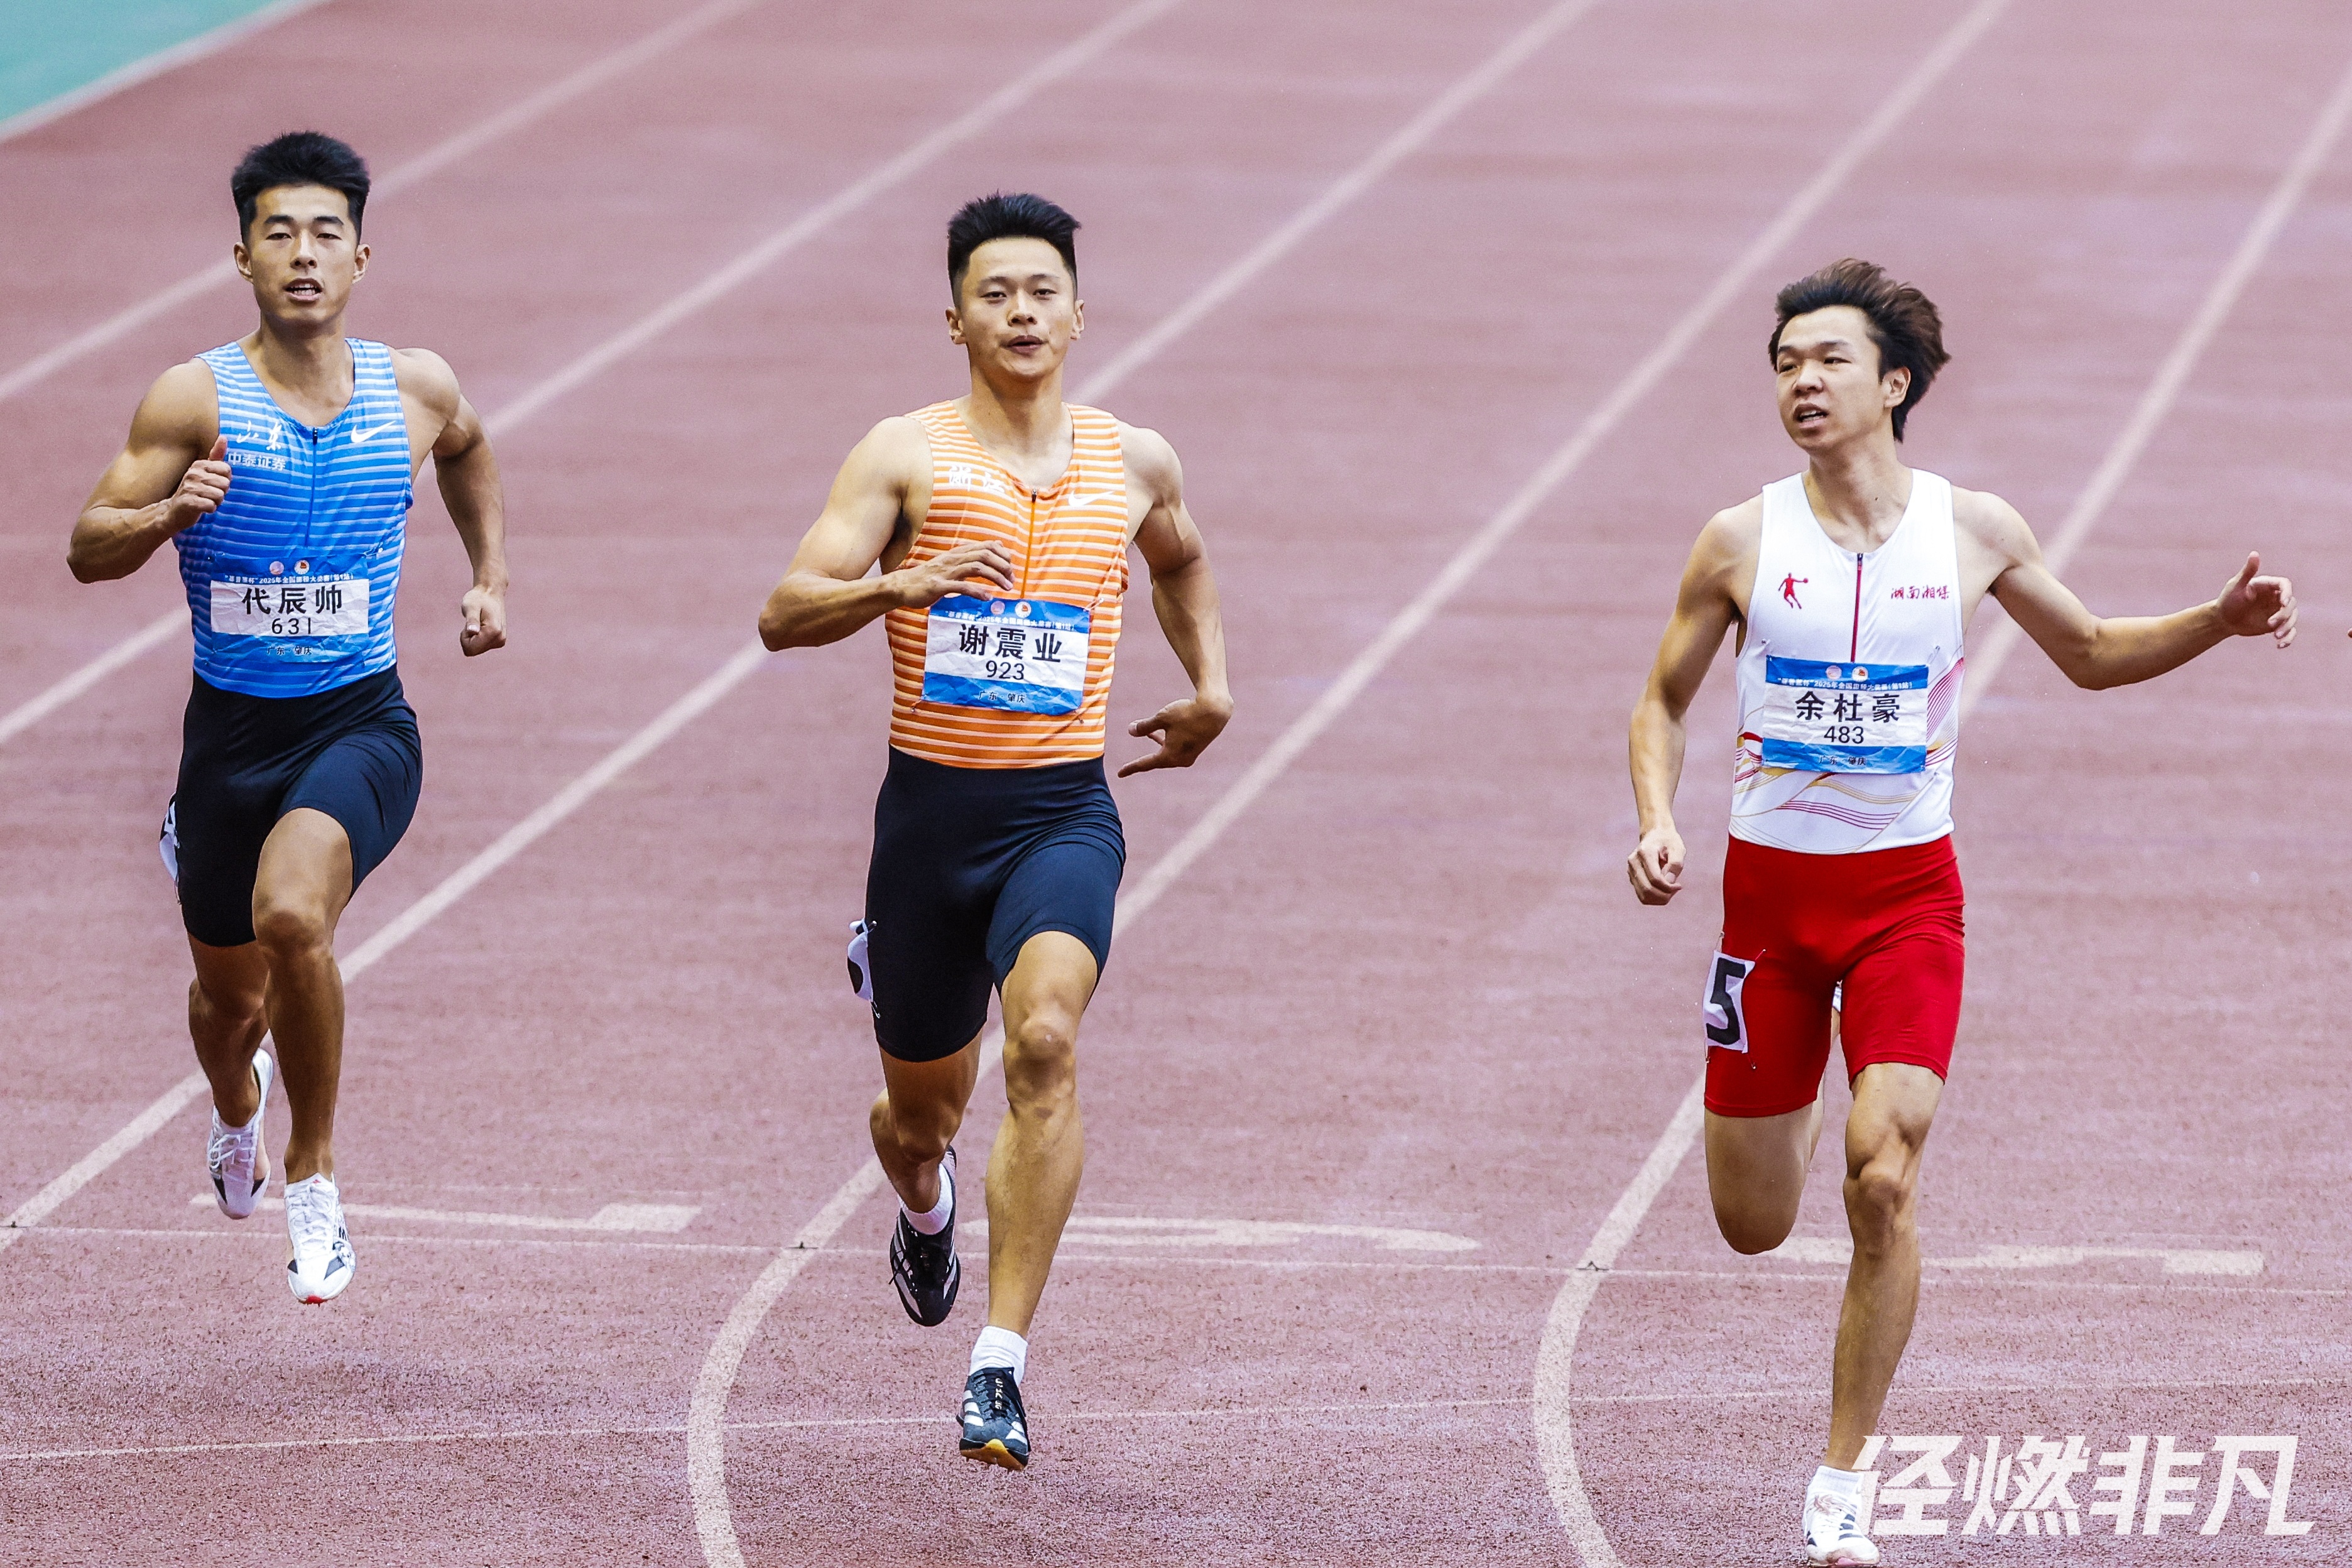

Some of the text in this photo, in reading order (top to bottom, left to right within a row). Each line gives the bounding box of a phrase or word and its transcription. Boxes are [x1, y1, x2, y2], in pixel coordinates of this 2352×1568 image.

[236, 420, 283, 451] 山东
[227, 452, 286, 471] 中泰证券
[241, 585, 342, 615] 代辰帅
[271, 618, 312, 634] 631
[959, 623, 1062, 662] 谢震业
[986, 660, 1025, 680] 923
[1795, 691, 1900, 723] 余杜豪
[1824, 726, 1864, 744] 483
[1706, 957, 1746, 1045] 5
